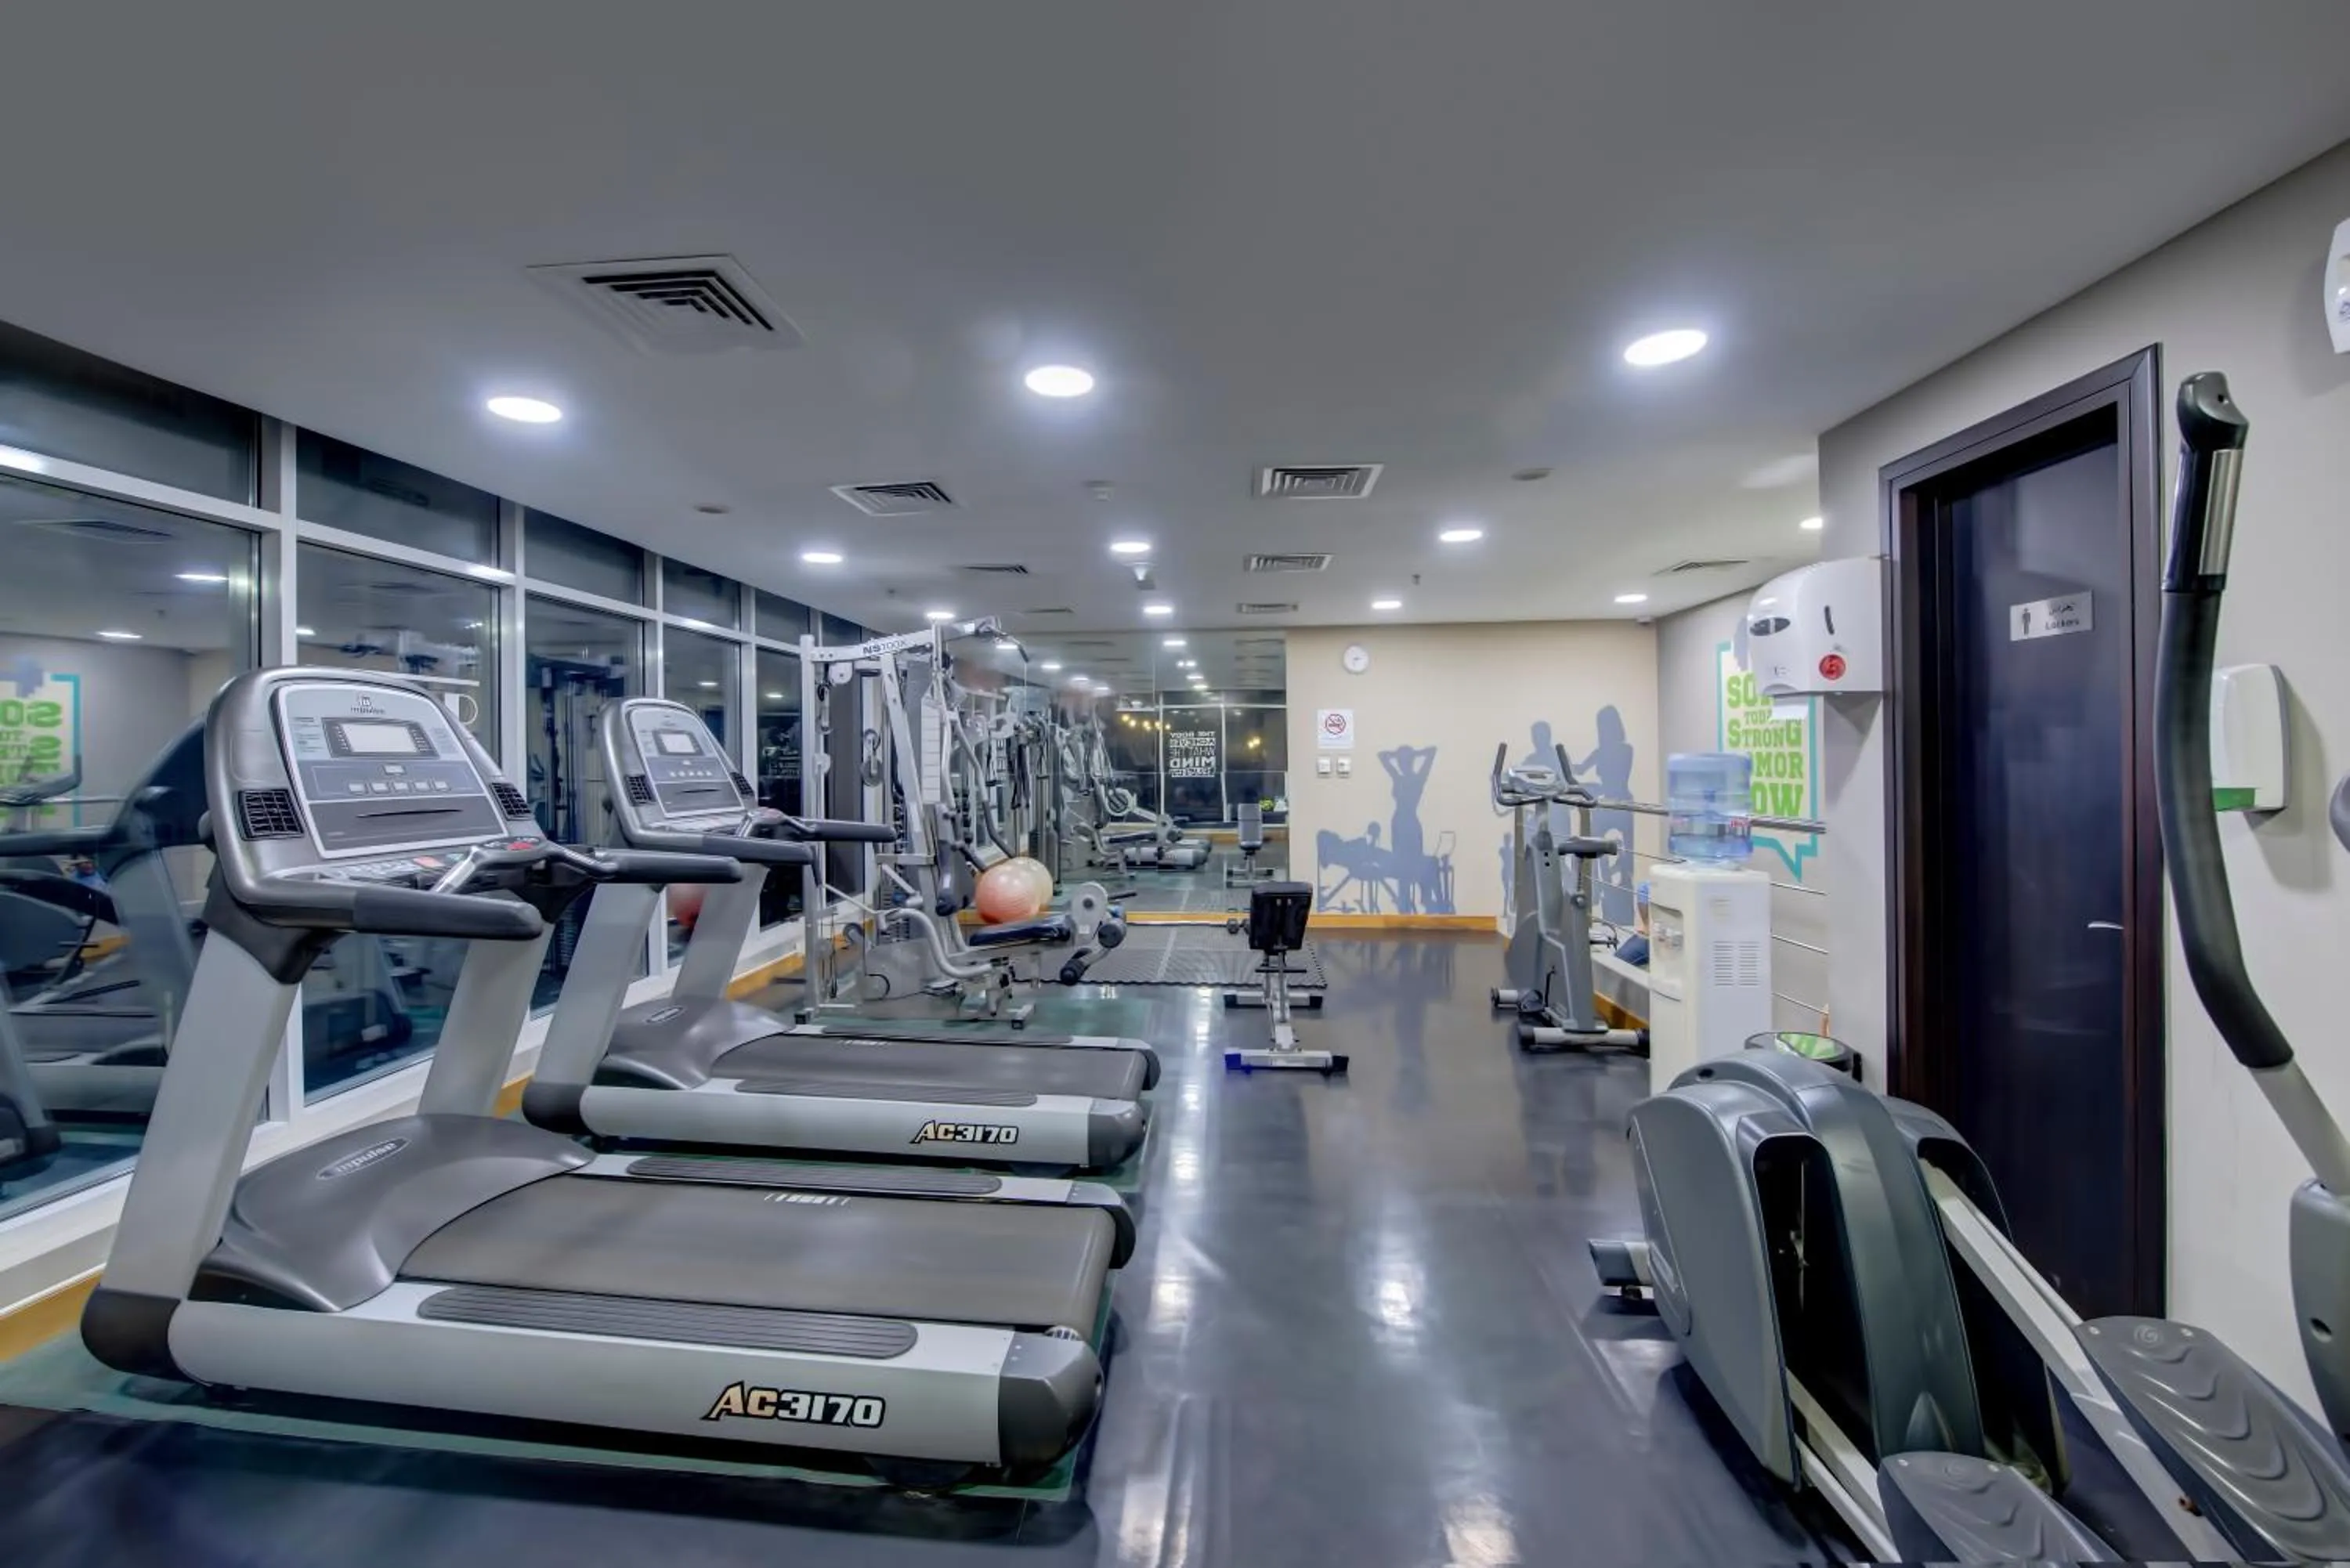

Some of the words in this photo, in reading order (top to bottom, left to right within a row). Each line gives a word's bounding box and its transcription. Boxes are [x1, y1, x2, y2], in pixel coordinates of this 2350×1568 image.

[1727, 718, 1802, 748] STRONG
[1755, 751, 1804, 779] MOR
[1751, 781, 1804, 816] OW
[909, 1119, 1019, 1144] AC3170
[700, 1381, 886, 1429] AC3170
